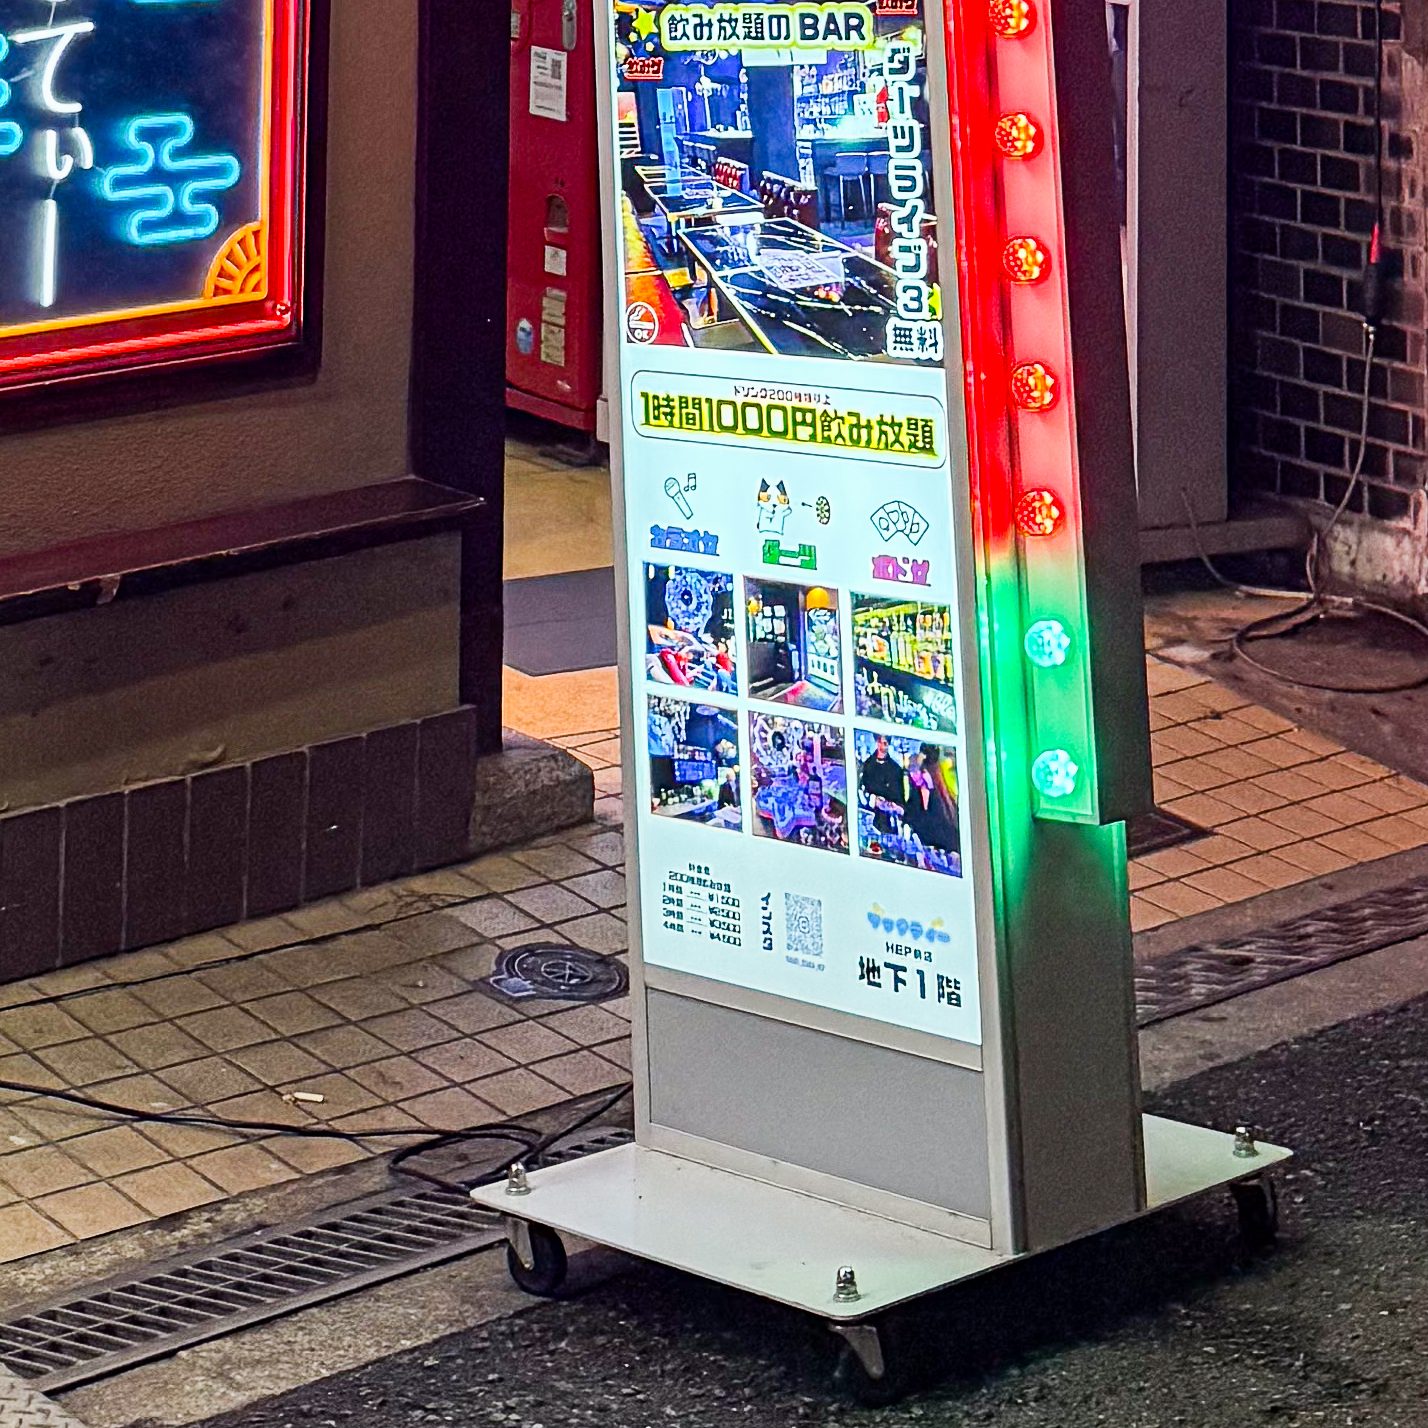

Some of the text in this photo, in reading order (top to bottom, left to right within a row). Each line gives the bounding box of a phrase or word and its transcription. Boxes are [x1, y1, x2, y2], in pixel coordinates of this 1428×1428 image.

[800, 12, 866, 41] BAR
[640, 391, 936, 455] 1時間1000円飲み放題
[858, 955, 962, 1008] 地下1階
